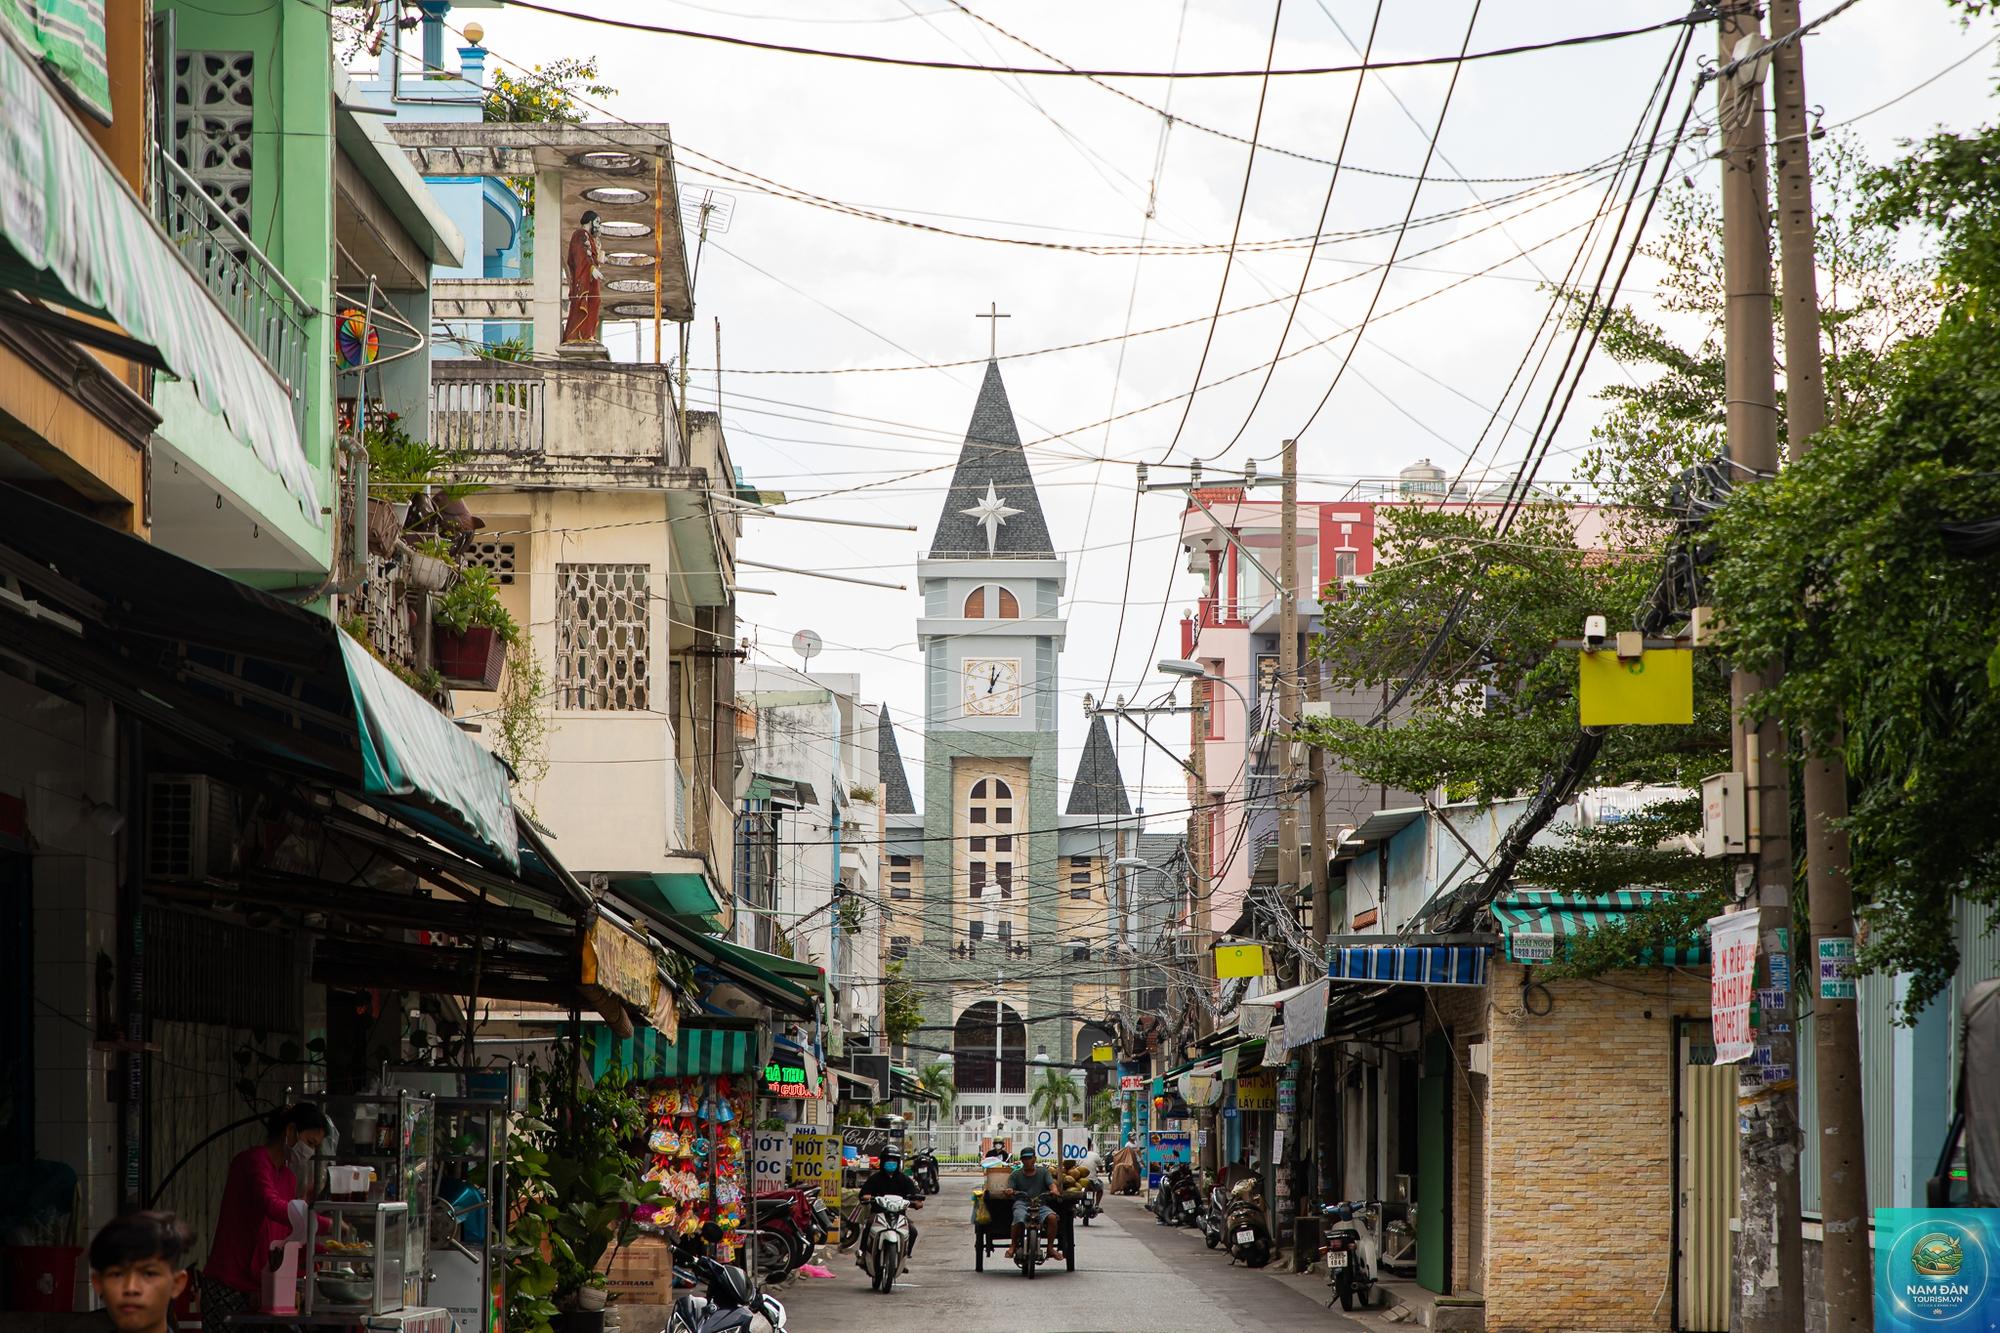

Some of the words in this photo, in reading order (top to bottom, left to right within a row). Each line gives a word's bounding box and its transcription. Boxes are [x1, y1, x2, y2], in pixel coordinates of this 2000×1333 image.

[1063, 1144, 1088, 1158] 000
[756, 1155, 781, 1174] ÓC
[795, 1158, 823, 1177] TÓC
